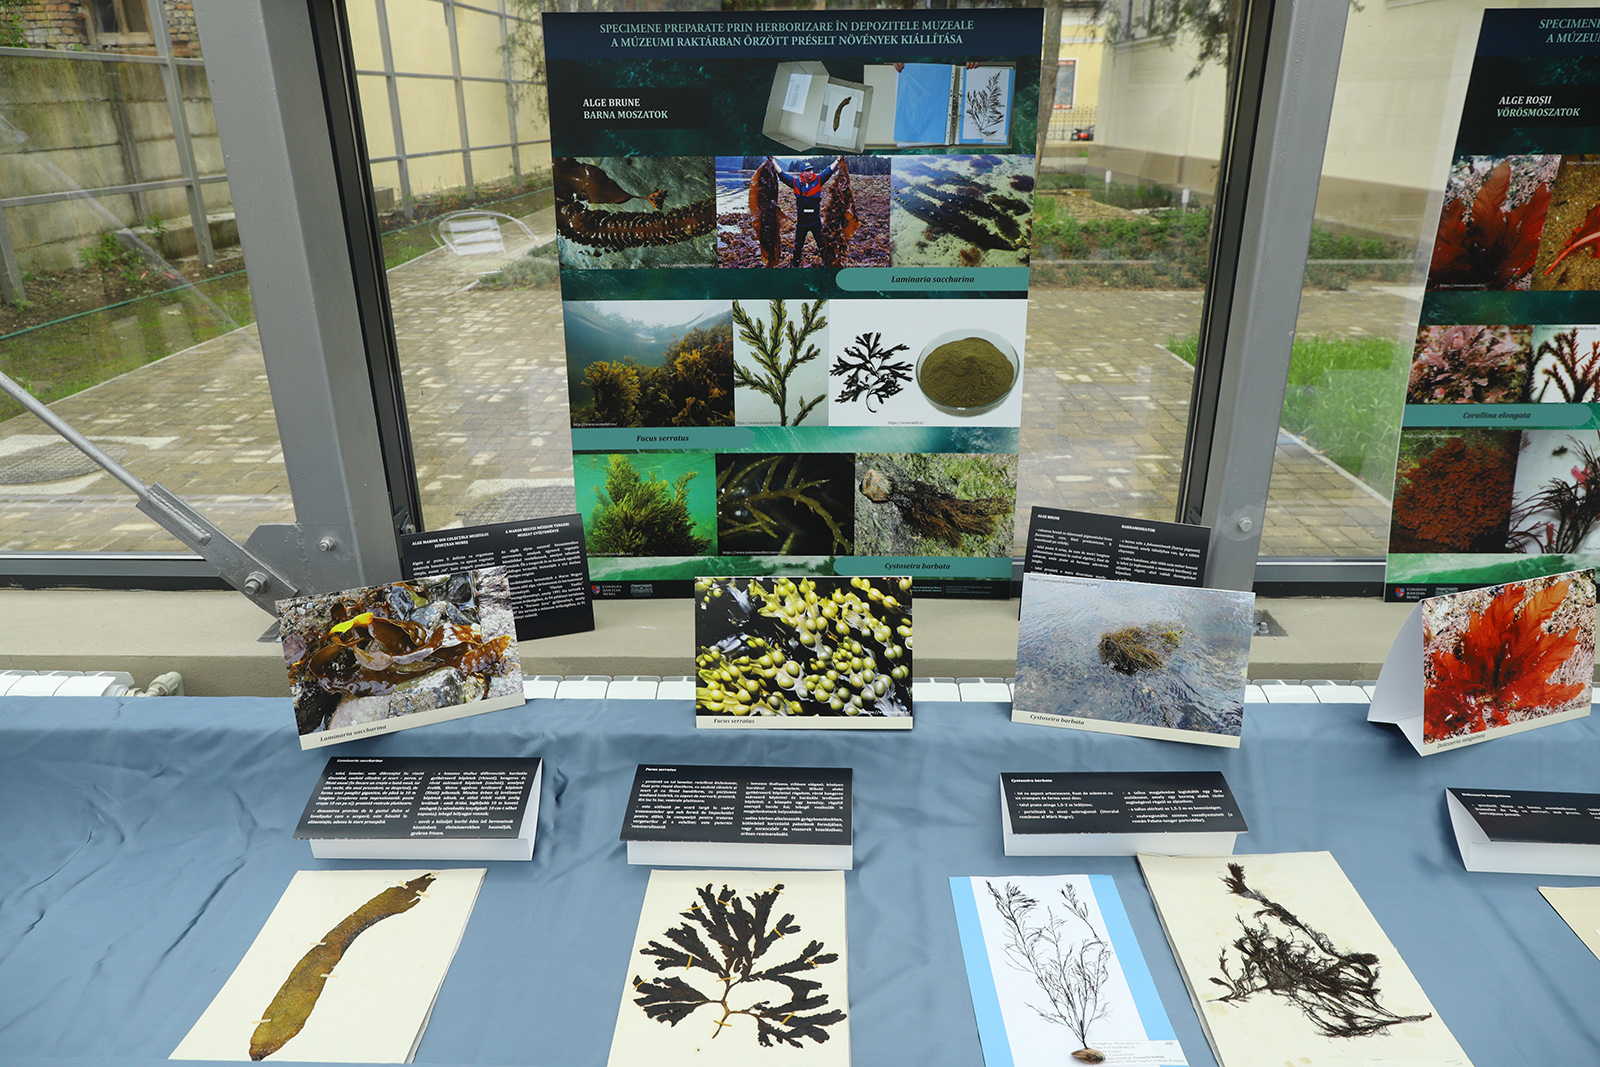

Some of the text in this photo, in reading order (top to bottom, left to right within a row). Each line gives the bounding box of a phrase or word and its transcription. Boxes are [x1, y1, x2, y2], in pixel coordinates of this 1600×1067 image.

[600, 20, 974, 33] SPECIMENE PREPARATE PRIN HERBORIZARE ÎN DEPOZITELE MUZEALE
[611, 33, 963, 47] A MÚZEUMI RAKTÁRBAN ŐRZÖTT PRÉSELT NÖVÉNYEK KIÁLLÍTÁSA
[1546, 31, 1600, 43] A MÚZEU
[584, 98, 640, 107] ALGE BRUNE
[1499, 96, 1552, 106] ALGE ROȘII
[584, 110, 668, 119] BARNA MOSZATOK
[1497, 107, 1580, 117] VÖRÖSMOSZATOK
[1498, 412, 1531, 420] elongata
[1030, 714, 1060, 722] Cystoseira
[321, 725, 387, 742] Laminaria saccharina
